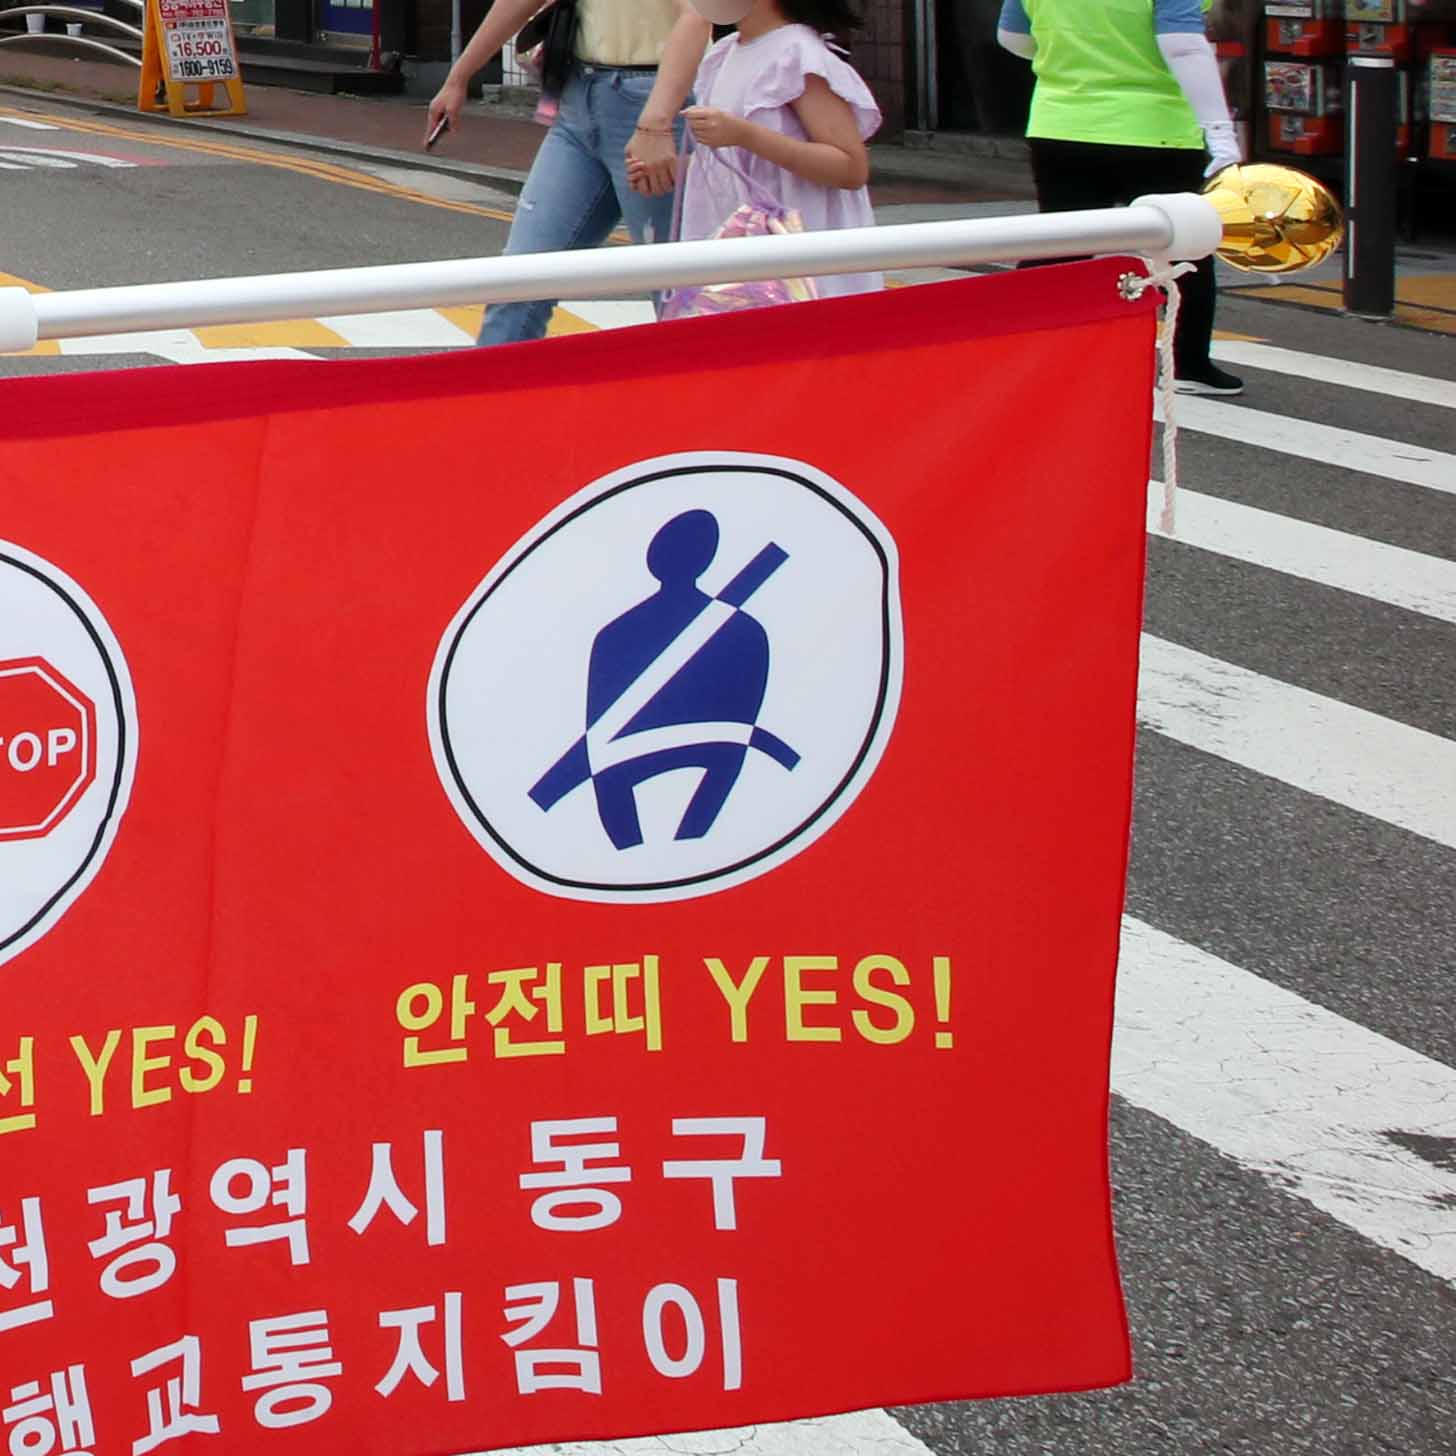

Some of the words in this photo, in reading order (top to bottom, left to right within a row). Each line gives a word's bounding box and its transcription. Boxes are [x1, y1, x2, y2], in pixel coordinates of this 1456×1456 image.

[177, 40, 222, 59] 16,500
[68, 1014, 260, 1116] YES!
[395, 955, 663, 1069] 안전띠
[704, 955, 953, 1049] YES!
[519, 1115, 782, 1233] 동구
